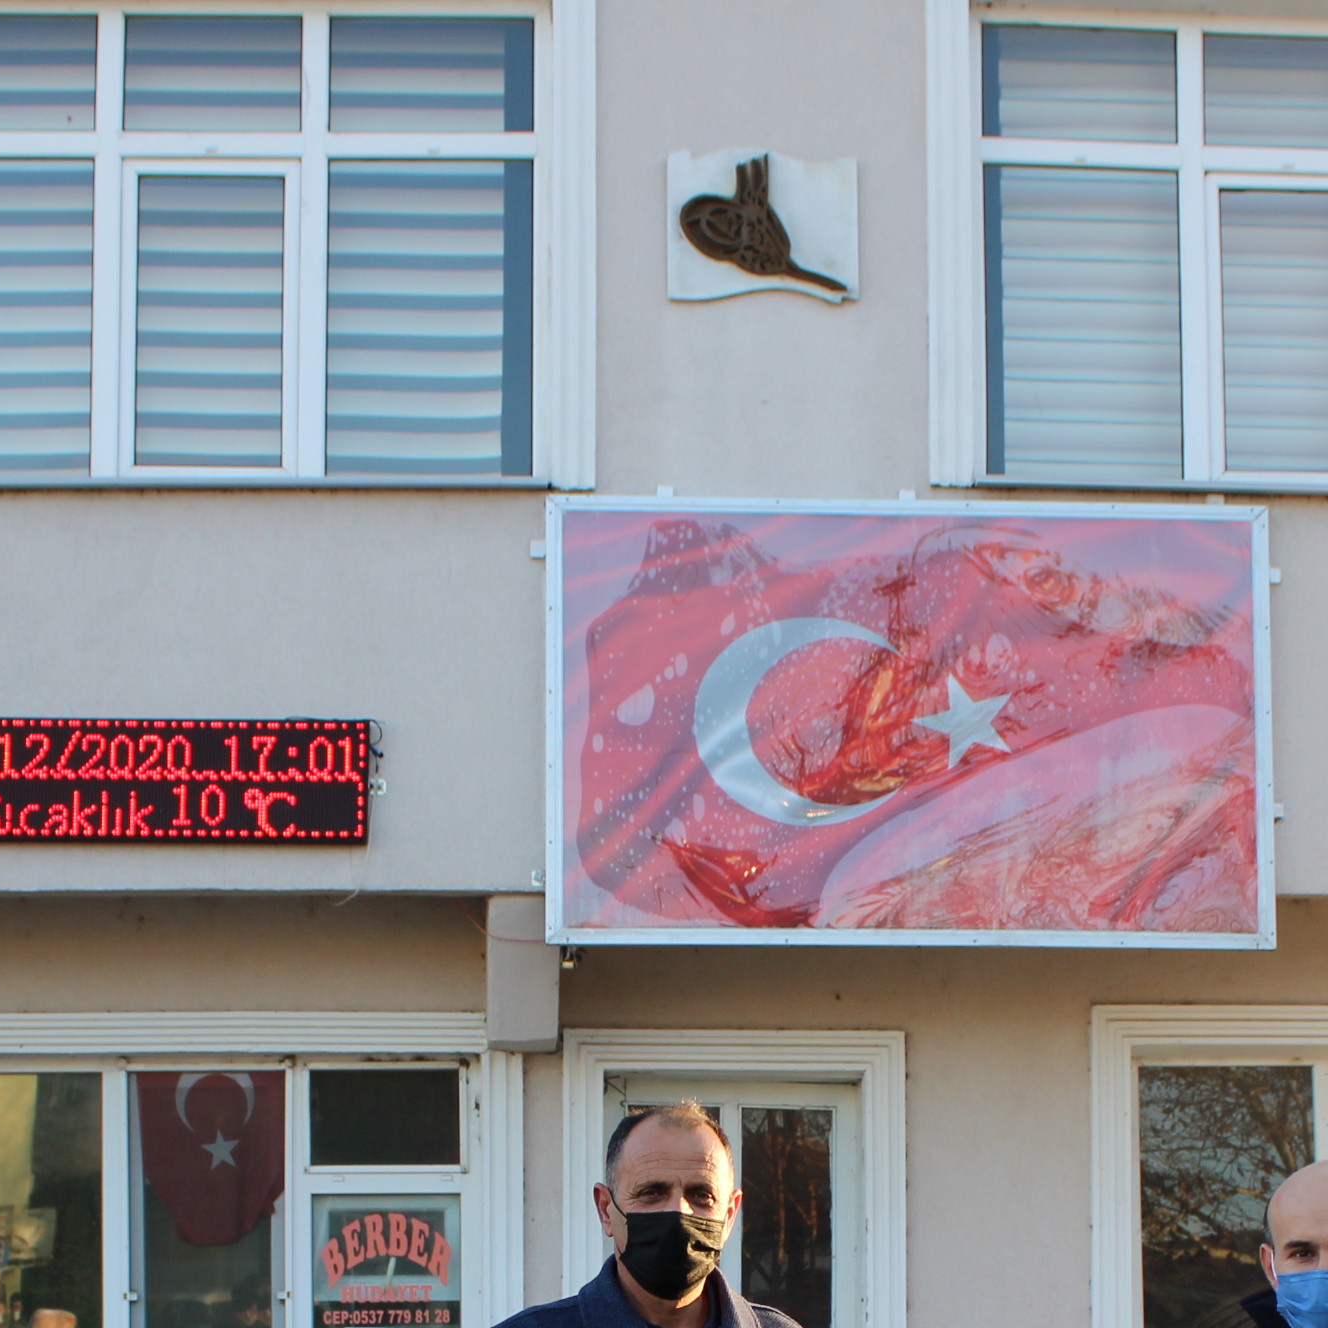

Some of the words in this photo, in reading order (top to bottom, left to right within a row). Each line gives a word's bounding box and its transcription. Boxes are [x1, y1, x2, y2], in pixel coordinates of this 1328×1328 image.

[224, 734, 354, 781] 17:01
[172, 783, 227, 827] 10
[320, 1211, 451, 1288] BERBER
[340, 1281, 433, 1303] HÜDAYET
[323, 1310, 384, 1325] CEP:0537
[388, 1310, 412, 1324] 779
[415, 1309, 430, 1323] 81
[435, 1309, 451, 1323] 28
